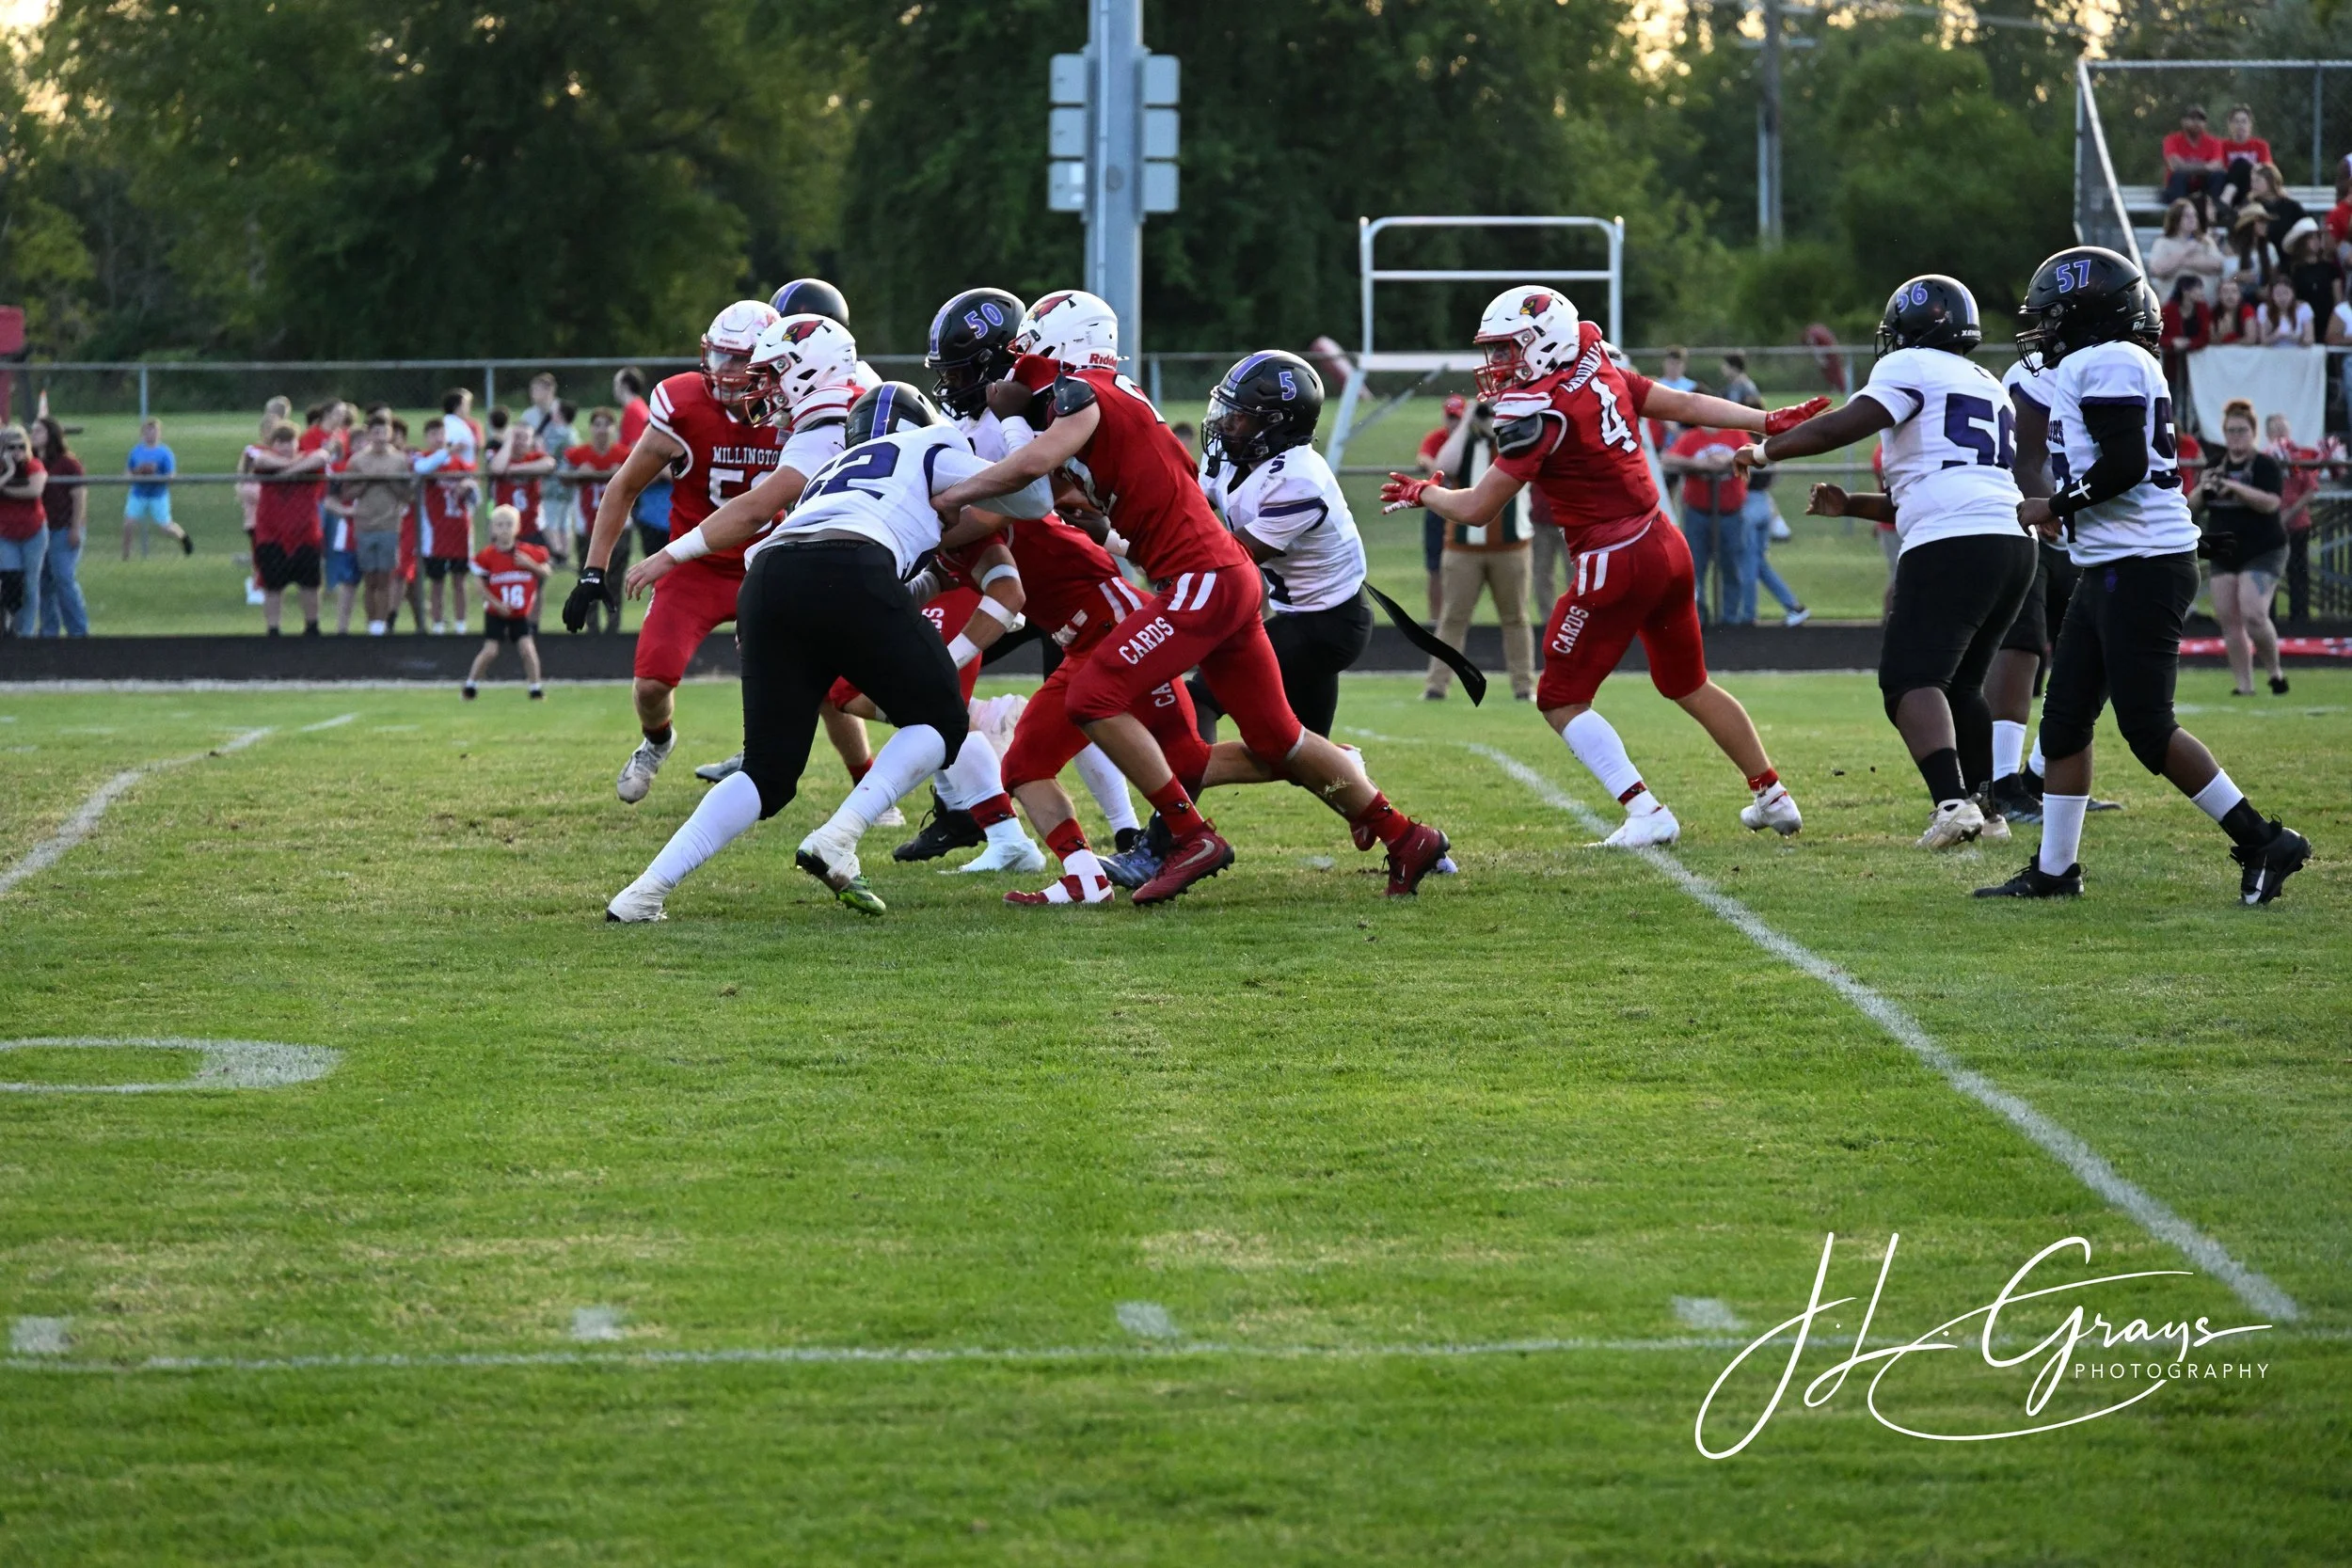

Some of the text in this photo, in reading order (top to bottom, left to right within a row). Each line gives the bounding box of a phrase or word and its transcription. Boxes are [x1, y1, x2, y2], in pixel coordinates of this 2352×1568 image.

[2056, 259, 2091, 293] 57
[1896, 281, 1929, 313] 56
[963, 302, 1004, 340] 50
[1279, 371, 1297, 402] 5
[1589, 375, 1638, 453] 4
[712, 446, 782, 466] MILLINGTO
[1268, 454, 1286, 474] 5
[1119, 616, 1175, 666] CARDS
[1550, 605, 1590, 655] CARDS
[1151, 681, 1177, 708] CA
